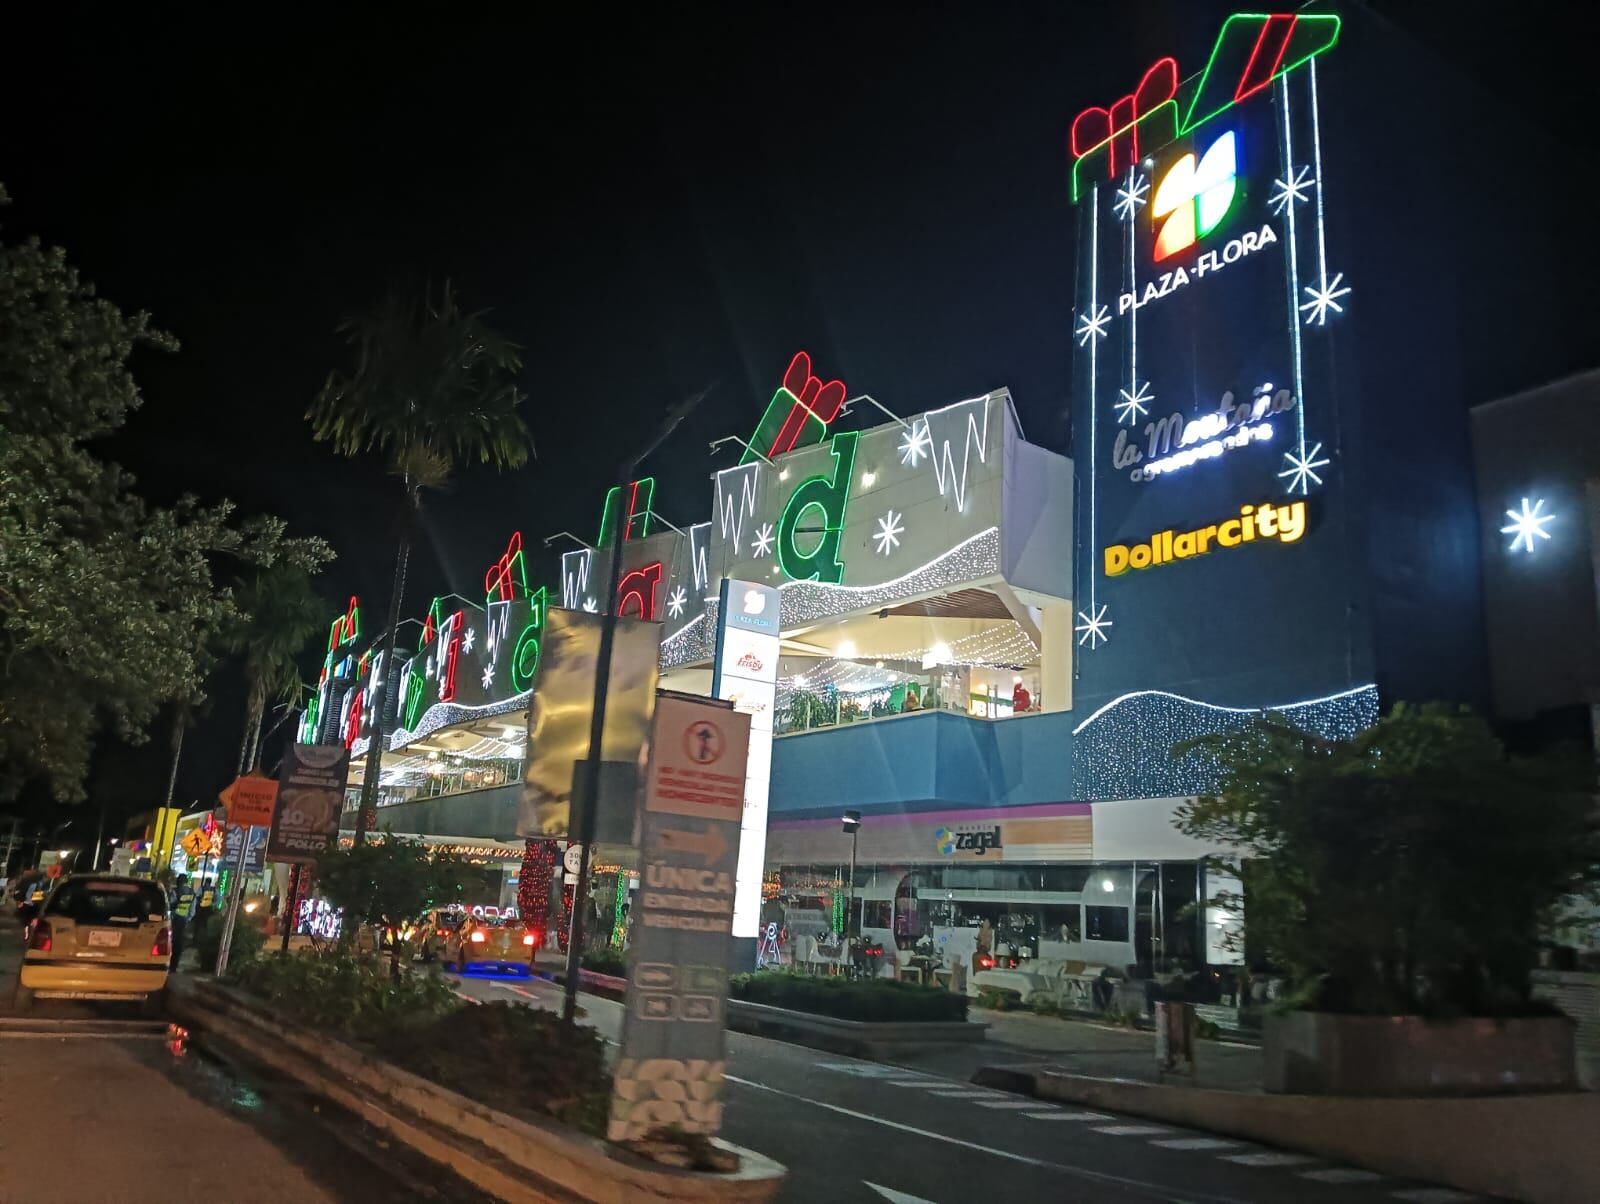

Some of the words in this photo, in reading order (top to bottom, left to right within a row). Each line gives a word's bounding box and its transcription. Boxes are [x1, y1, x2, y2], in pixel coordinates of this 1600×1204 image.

[1104, 502, 1307, 578] Dollarcity
[737, 656, 764, 672] Frisby
[956, 826, 1003, 856] zagal
[646, 859, 733, 894] ÚNICA
